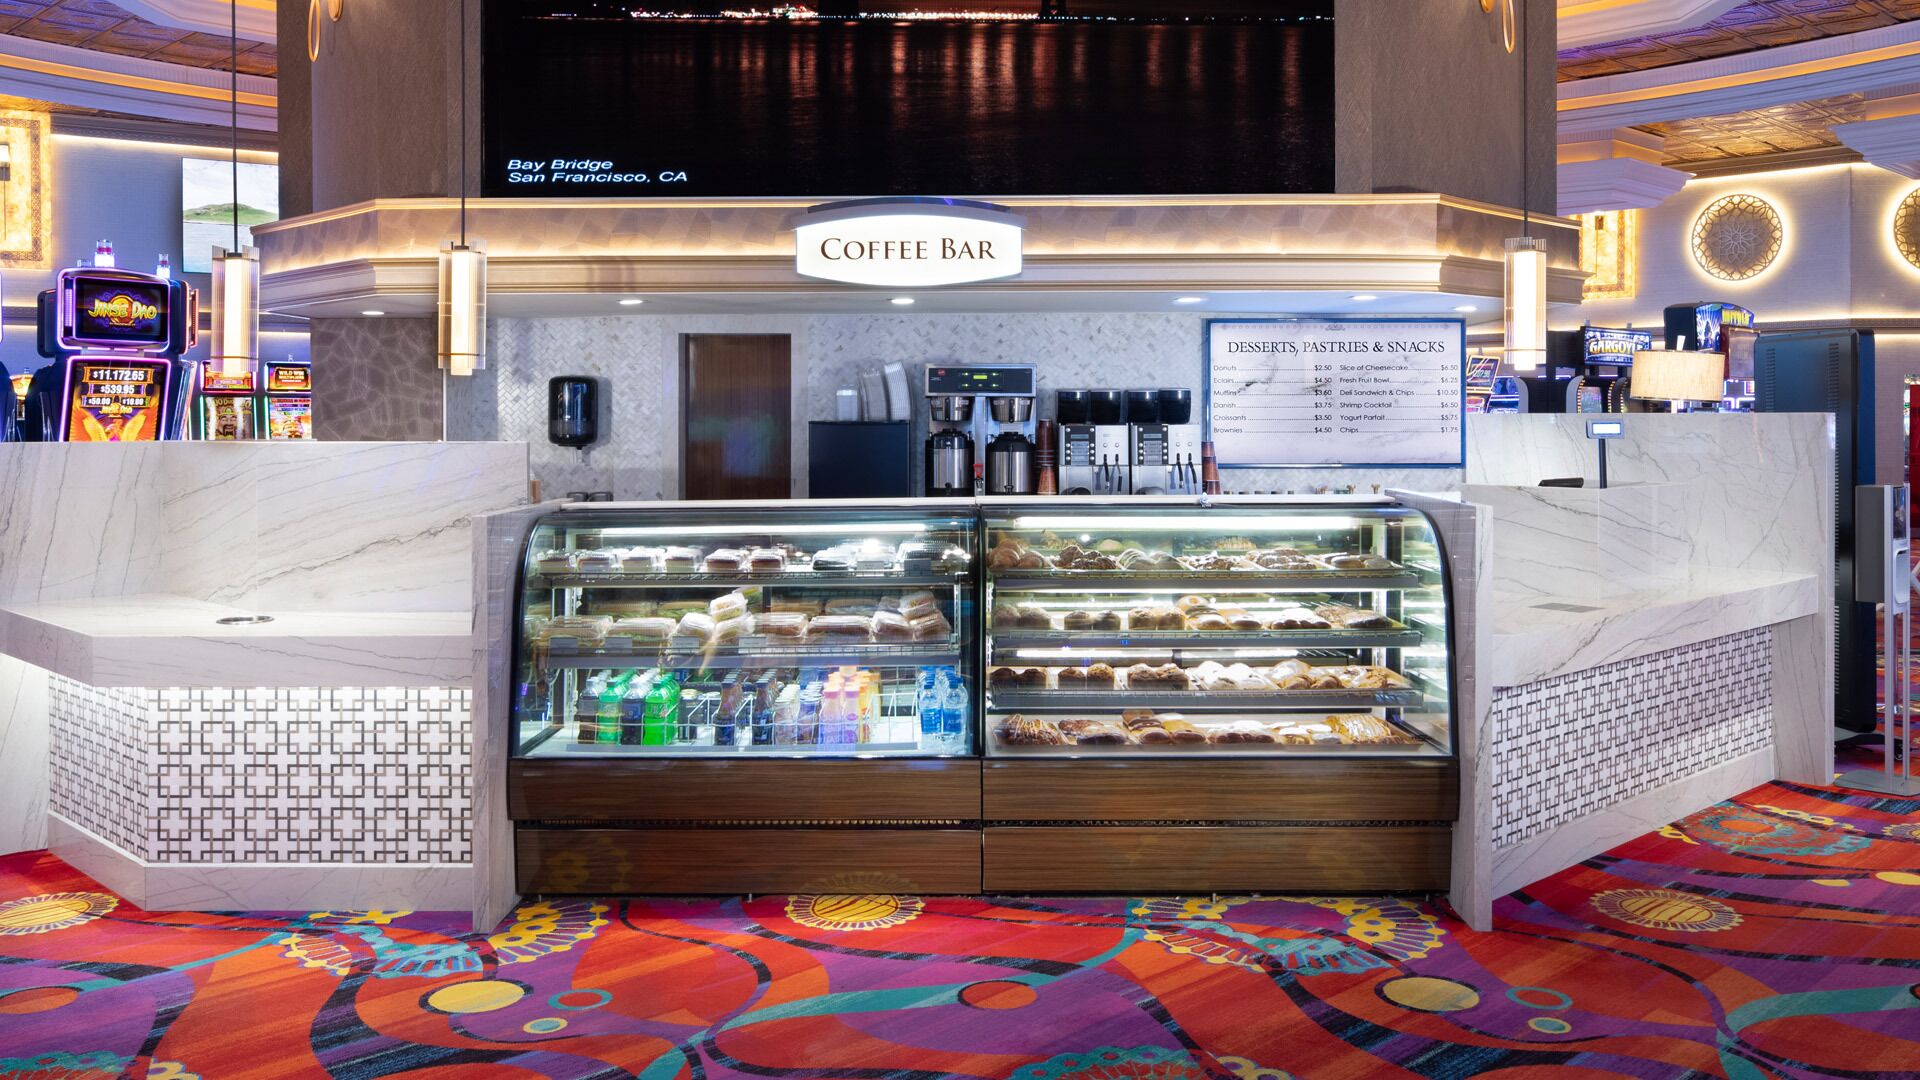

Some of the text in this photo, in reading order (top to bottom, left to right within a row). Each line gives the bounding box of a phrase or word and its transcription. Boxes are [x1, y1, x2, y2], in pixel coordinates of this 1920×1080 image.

[507, 159, 613, 172] Bay Bridge
[508, 171, 688, 183] San Francisco, CA
[131, 301, 158, 320] DAO
[1227, 341, 1445, 357] DESSERTS, PASTRIES & SNACKS
[100, 384, 135, 394] $539.95
